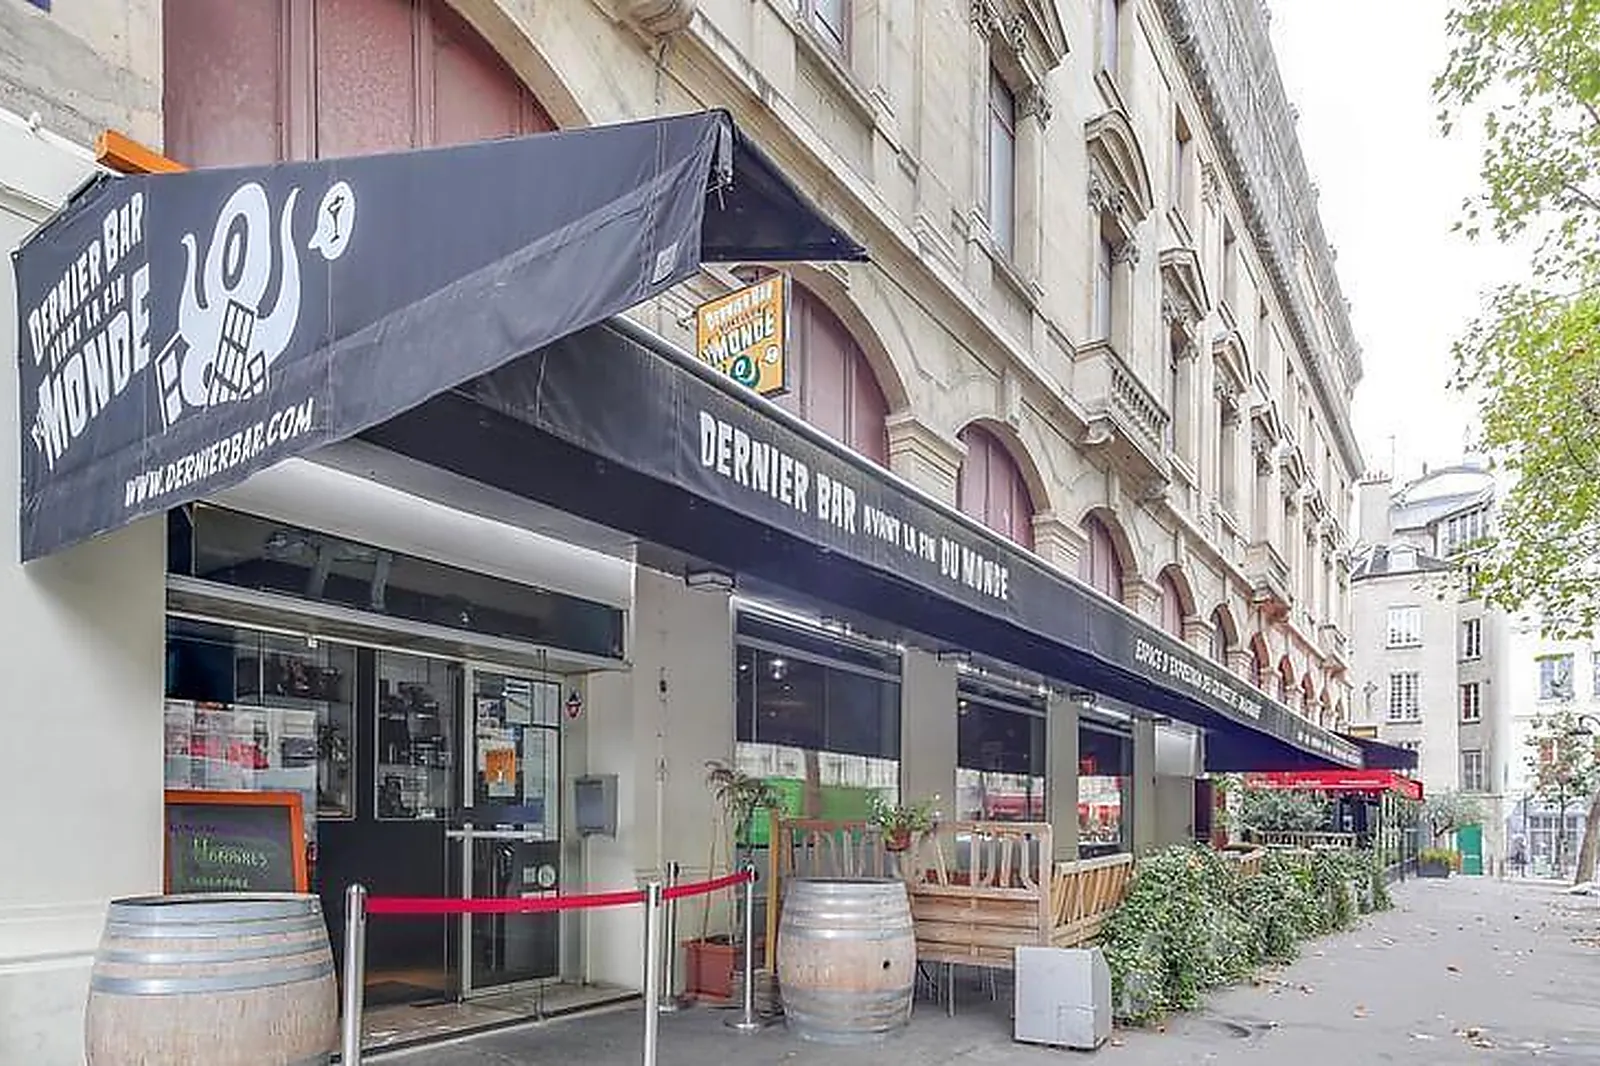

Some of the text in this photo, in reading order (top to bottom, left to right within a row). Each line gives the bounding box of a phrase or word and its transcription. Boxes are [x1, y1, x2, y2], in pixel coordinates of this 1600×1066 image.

[28, 240, 101, 366] DERNIER
[103, 192, 143, 273] BAR
[38, 262, 150, 470] MONDE
[125, 397, 314, 507] WWW.DERNIERBAR.COM
[700, 410, 809, 513] DERNIER
[817, 473, 856, 534] BAR
[941, 536, 959, 580] DU
